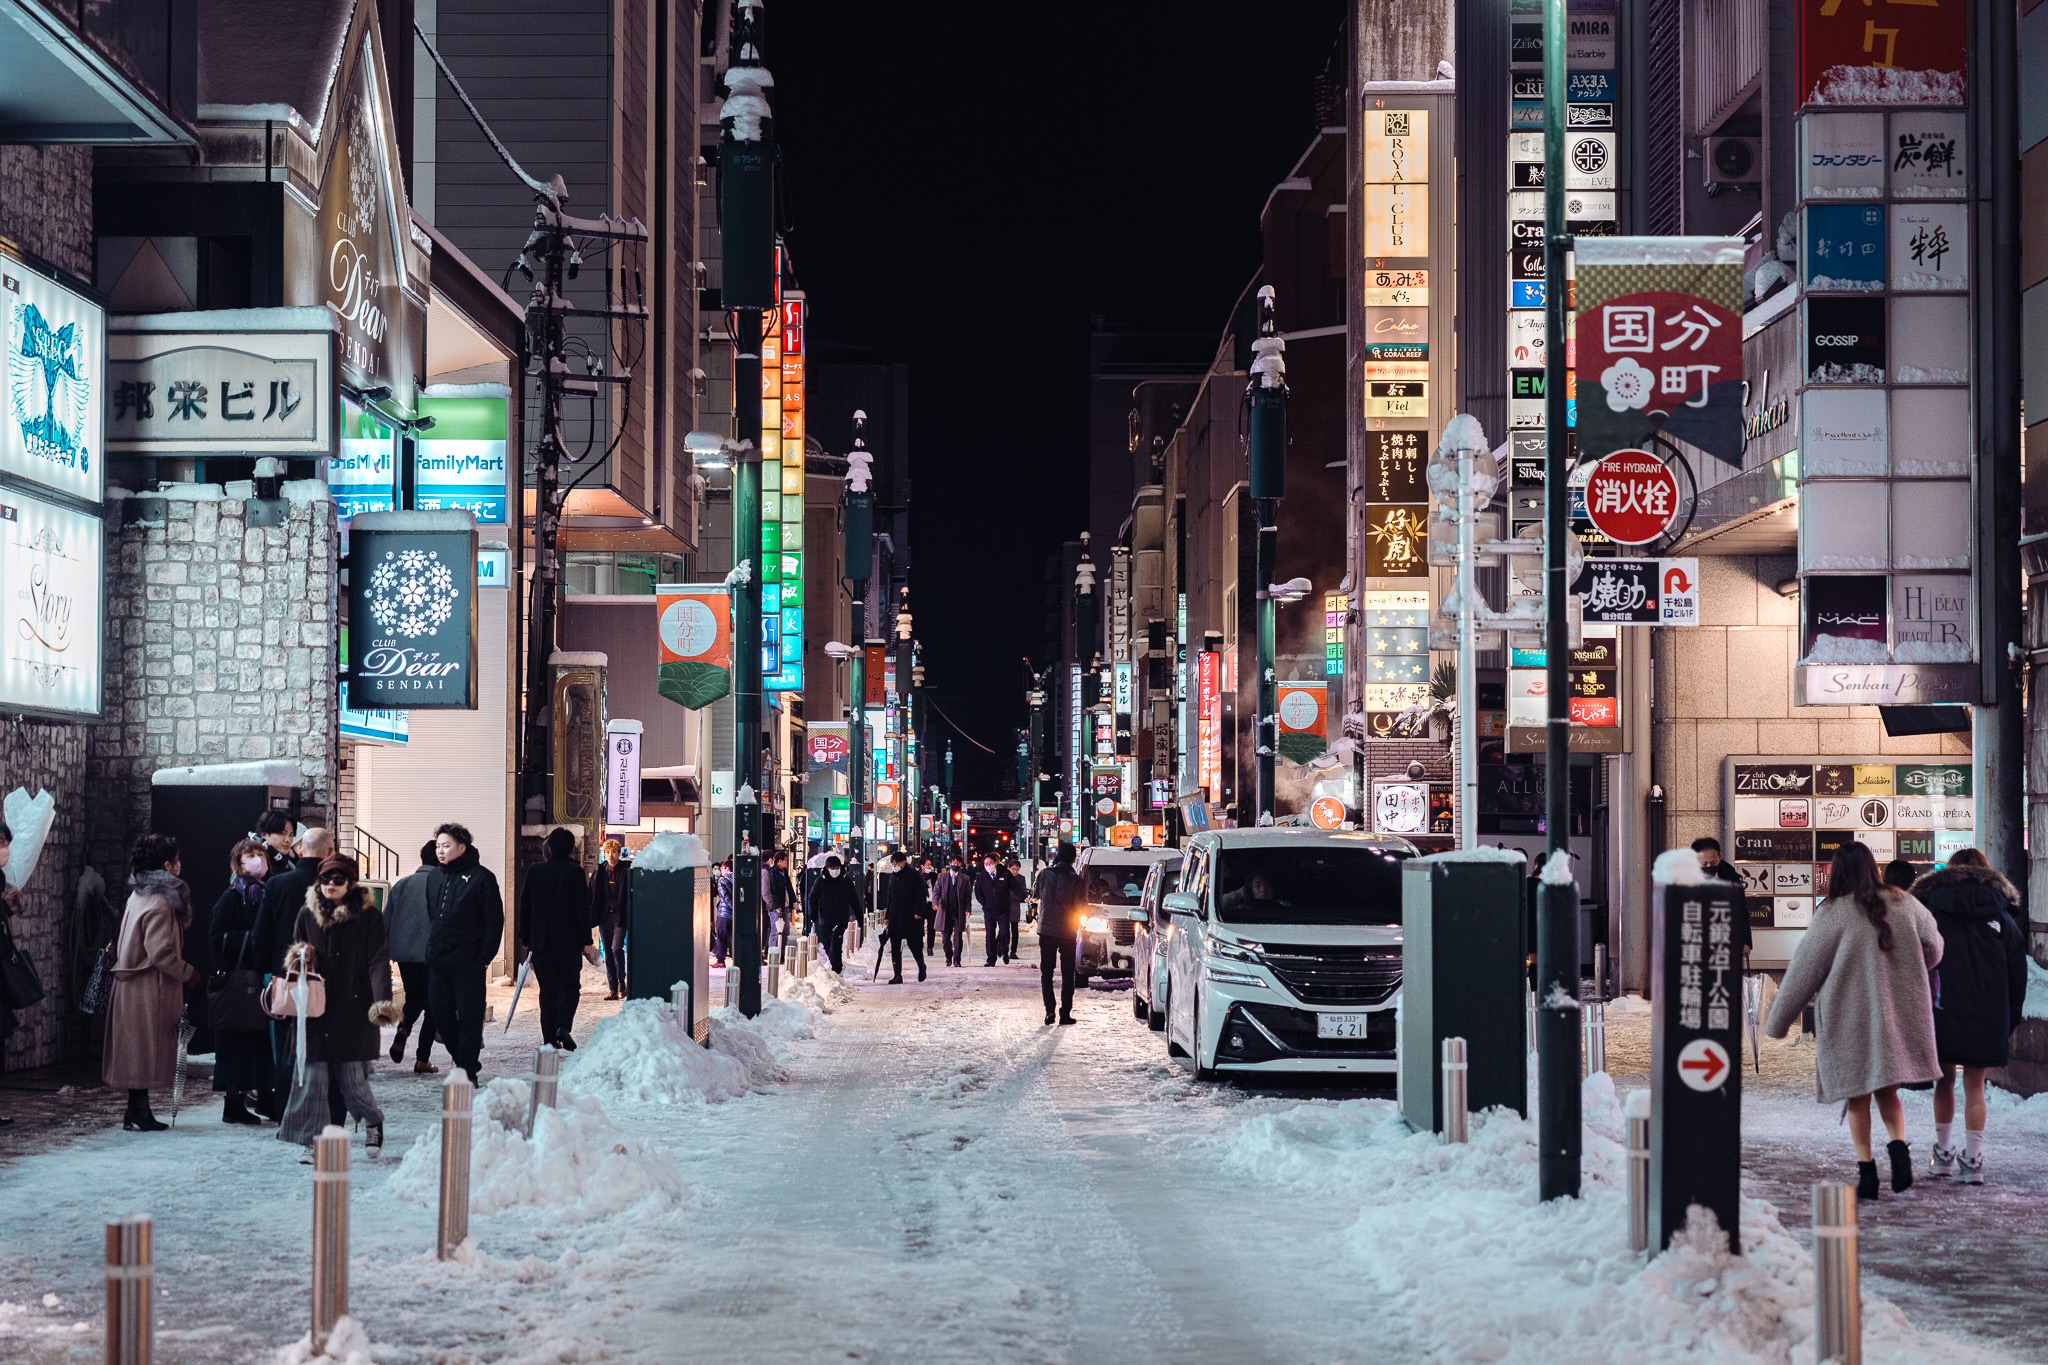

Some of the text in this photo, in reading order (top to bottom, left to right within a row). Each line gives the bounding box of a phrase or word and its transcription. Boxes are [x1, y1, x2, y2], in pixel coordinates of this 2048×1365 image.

[1571, 21, 1609, 35] MIRA
[1577, 49, 1606, 59] Barbie
[1577, 90, 1602, 98] アクシア
[1375, 99, 1386, 108] 4F
[1391, 138, 1404, 195] ROYAL
[1812, 154, 1883, 167] ファンタジー
[1591, 177, 1611, 186] EVE
[336, 211, 357, 238] CLUB
[1391, 203, 1404, 246] CLUB
[1375, 258, 1386, 269] 3F
[365, 270, 380, 298] ディア
[326, 238, 388, 344] Dear
[1602, 304, 1723, 355] 国分
[1815, 335, 1858, 346] GOSSIP
[339, 331, 380, 378] SENDAI
[1661, 364, 1722, 409] 町
[113, 380, 301, 423] 邦栄ビル
[1386, 400, 1409, 411] Viel
[1375, 419, 1386, 428] 2F
[1390, 433, 1404, 471] 焼肉と
[1405, 433, 1418, 484] 牛刺しと
[417, 454, 503, 474] FamilyMart
[1378, 434, 1390, 501] しゃぶしゃぶと。
[1602, 462, 1663, 474] FIRE HYDRANT
[1594, 478, 1671, 515] 消火栓
[19, 563, 73, 653] Story
[1663, 597, 1693, 608] 千松島
[1903, 586, 1925, 620] H
[1934, 597, 1966, 612] BEAT
[1818, 616, 1880, 625] MAC
[677, 606, 694, 653] 国分町
[372, 639, 396, 647] CLUB
[358, 647, 460, 677] Dear
[413, 651, 440, 662] ディア
[1574, 652, 1605, 660] NISHIKI
[1327, 663, 1336, 671] B1
[376, 679, 443, 690] SENDAI
[1118, 671, 1129, 706] 東ビル
[1824, 672, 1949, 697] Senkan Plaza
[814, 737, 843, 750] 国分
[1568, 732, 1601, 744] Plaza
[828, 751, 843, 762] 町
[1737, 773, 1782, 790] ZERO
[1857, 775, 1891, 785] Aladdin
[1913, 774, 1957, 785] Eternal
[1497, 780, 1573, 795] ALLUE
[1384, 793, 1399, 825] 田中
[1781, 802, 1806, 811] Lounge
[1897, 810, 1933, 818] GRAND
[1735, 836, 1773, 848] Cran
[1821, 842, 1841, 850] Jungle
[1900, 839, 1932, 854] EMI
[1777, 873, 1810, 884] のわな
[1781, 911, 1805, 920] lehua
[1680, 900, 1703, 1030] 自転車駐輪場
[1708, 901, 1731, 1030] 元鍛冶丁公園
